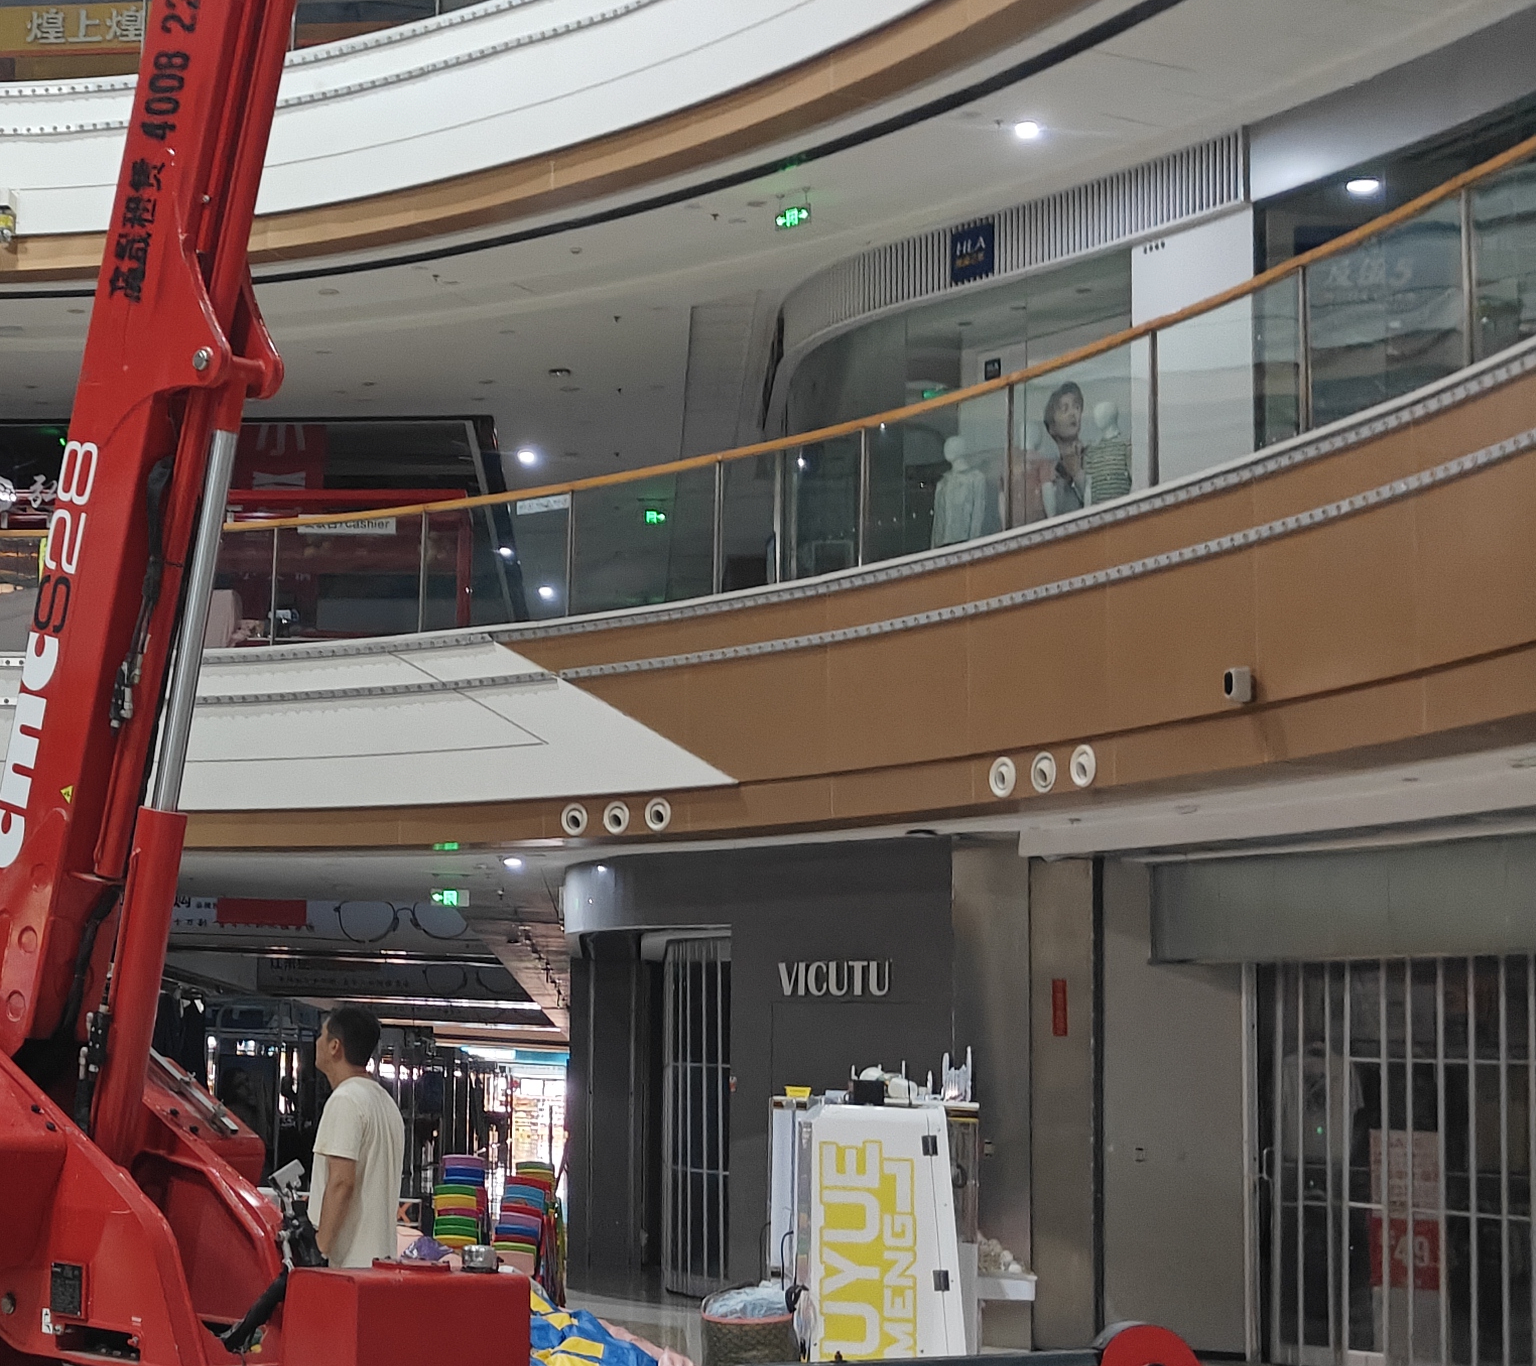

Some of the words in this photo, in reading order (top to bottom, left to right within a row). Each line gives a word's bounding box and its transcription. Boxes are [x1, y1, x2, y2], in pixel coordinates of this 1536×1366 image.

[25, 6, 145, 44] 煌上煌
[956, 236, 986, 256] HLA
[777, 960, 890, 997] VICUTU
